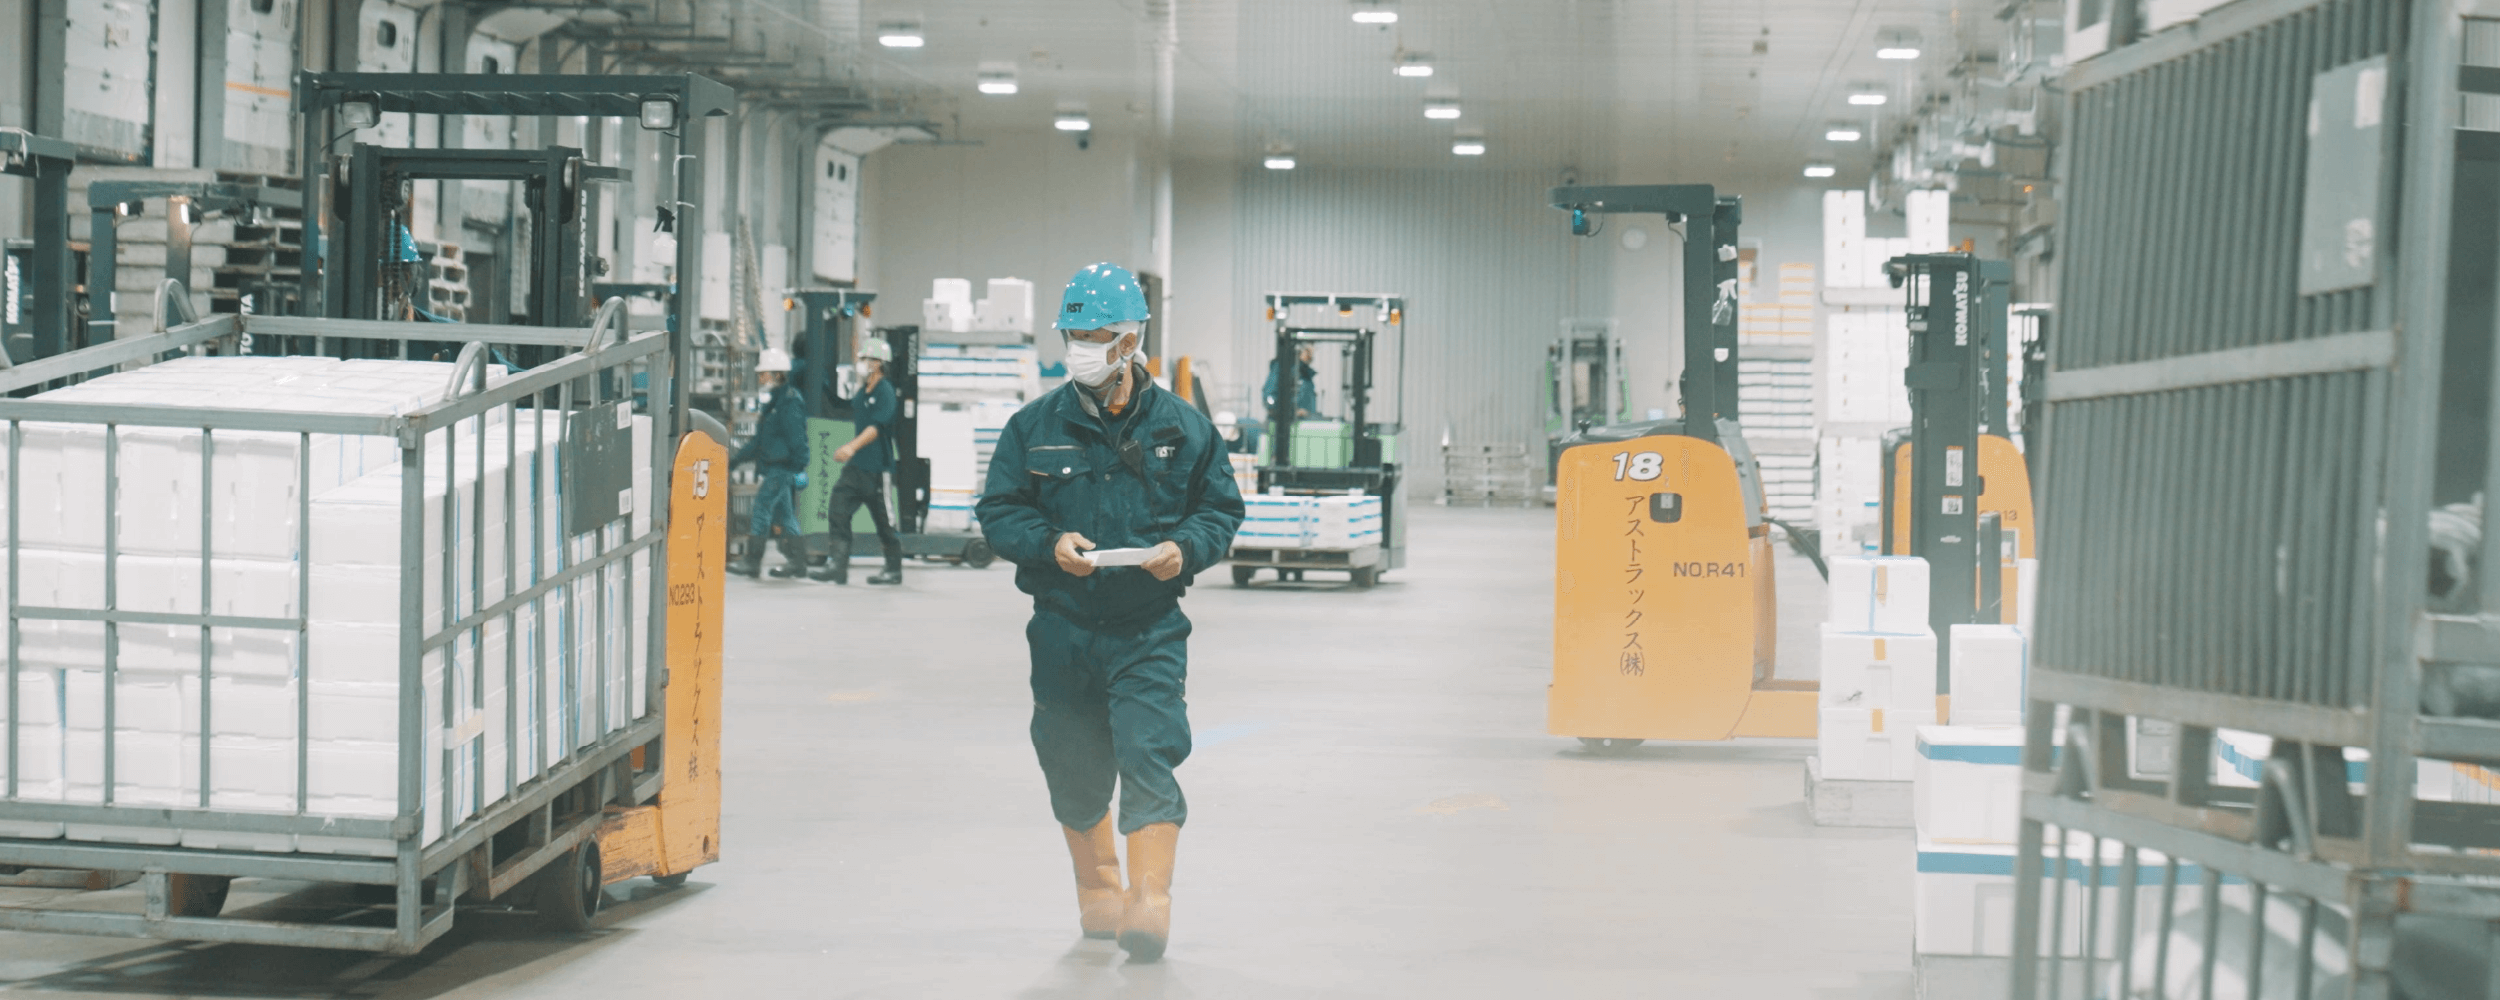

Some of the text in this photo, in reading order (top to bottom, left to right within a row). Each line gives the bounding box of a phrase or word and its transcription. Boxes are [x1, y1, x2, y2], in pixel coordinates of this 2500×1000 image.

[579, 189, 587, 297] KOMATSU
[240, 293, 253, 356] TOTA
[1953, 270, 1968, 346] KOMATSU
[692, 459, 709, 499] 15
[1612, 451, 1664, 481] 18
